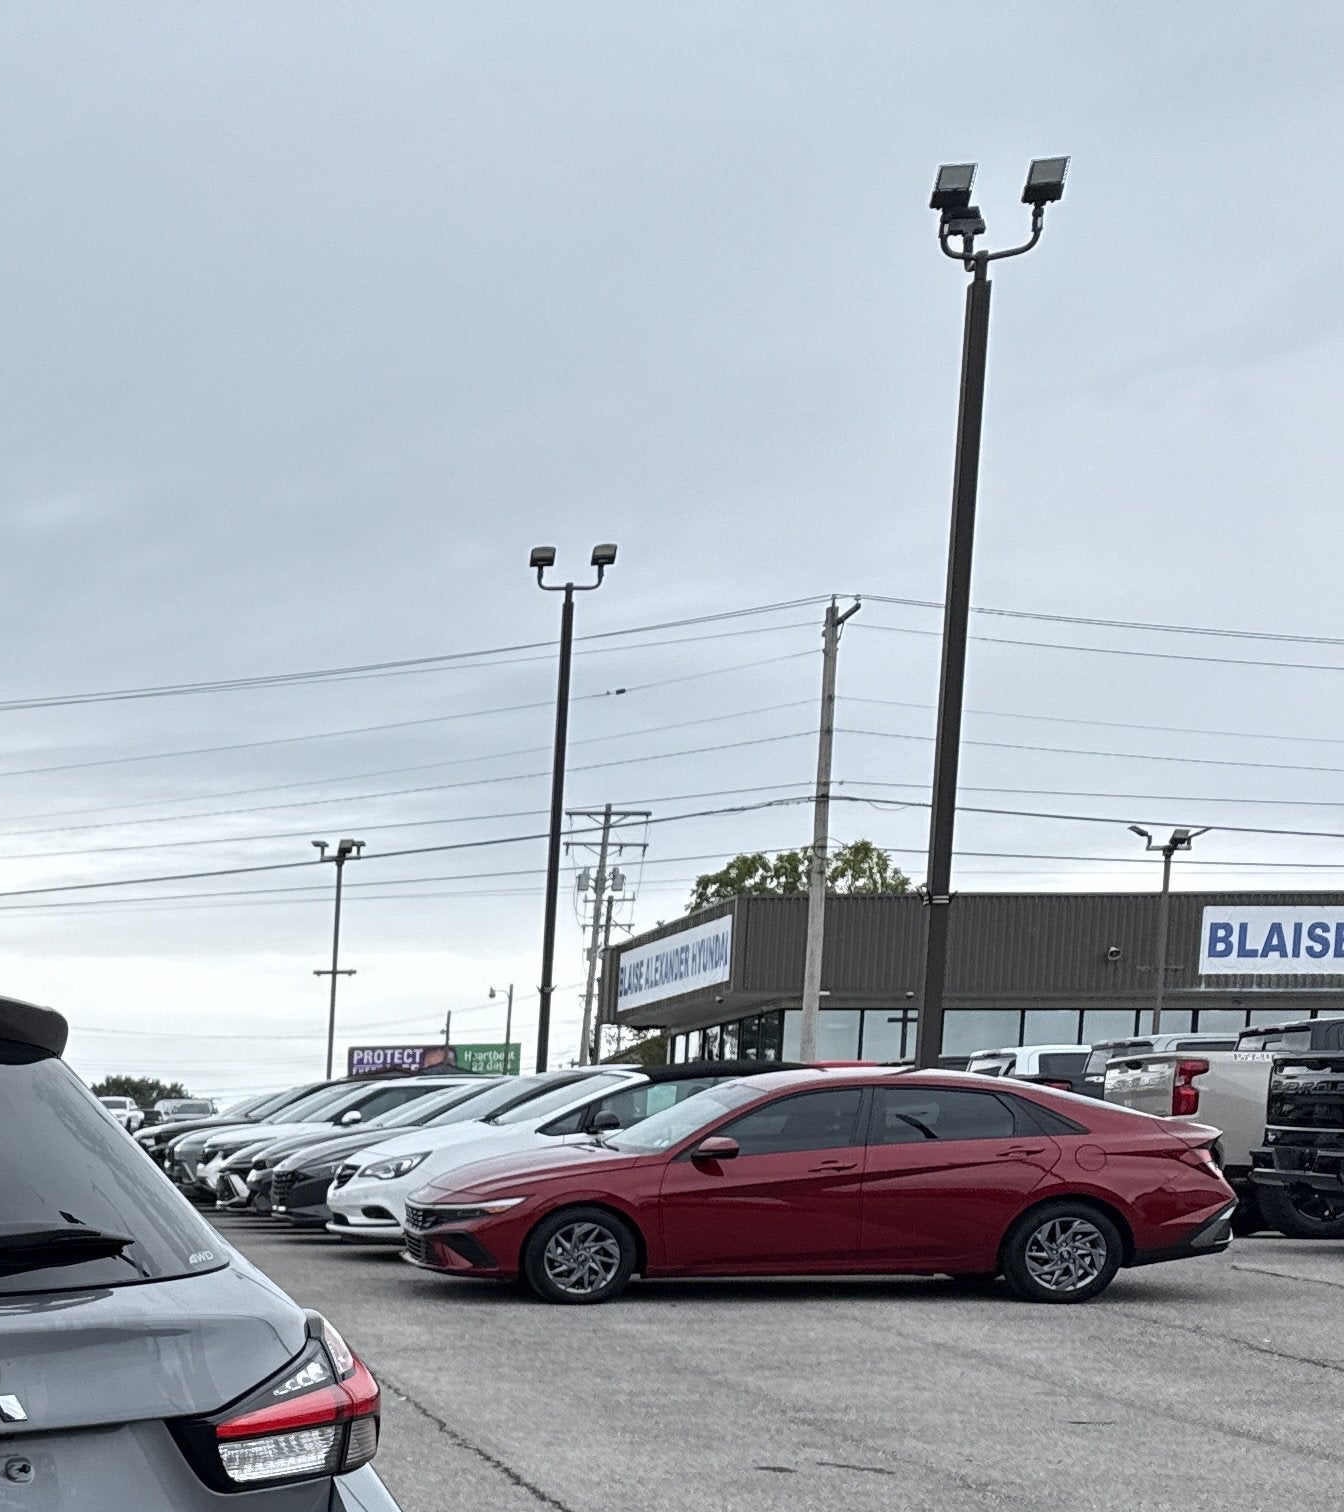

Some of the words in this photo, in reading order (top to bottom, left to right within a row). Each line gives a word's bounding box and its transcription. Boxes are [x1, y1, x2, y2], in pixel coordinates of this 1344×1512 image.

[618, 960, 644, 998] BLAISE
[643, 943, 690, 991] ALEXANDER
[691, 929, 729, 977] HYUNDAI
[353, 1048, 424, 1065] PROTECT
[189, 1250, 214, 1264] AWD
